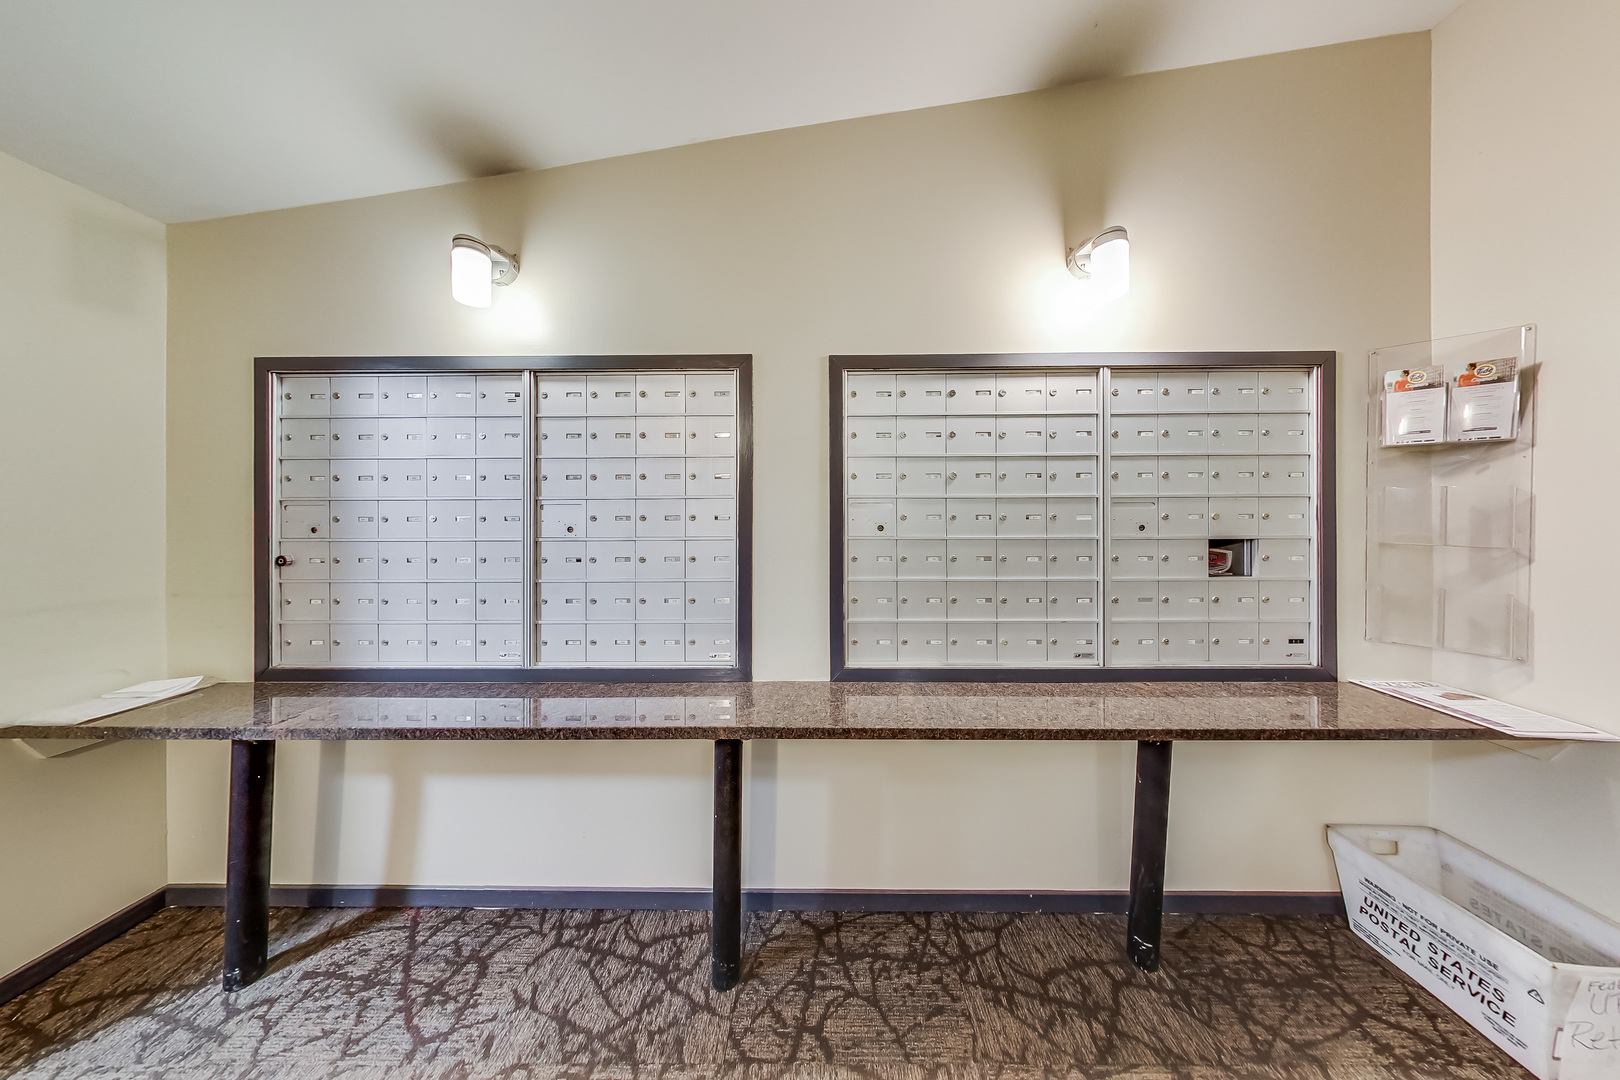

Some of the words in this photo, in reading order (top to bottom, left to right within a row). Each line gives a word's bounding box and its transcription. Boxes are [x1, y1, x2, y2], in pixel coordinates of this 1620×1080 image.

[1359, 905, 1421, 958] POSTAL
[1427, 956, 1517, 1028] SERVICE
[1363, 896, 1421, 942] UNITED
[1427, 941, 1506, 1003] STATES
[1440, 928, 1477, 956] PRIVATE
[1479, 954, 1499, 971] USE
